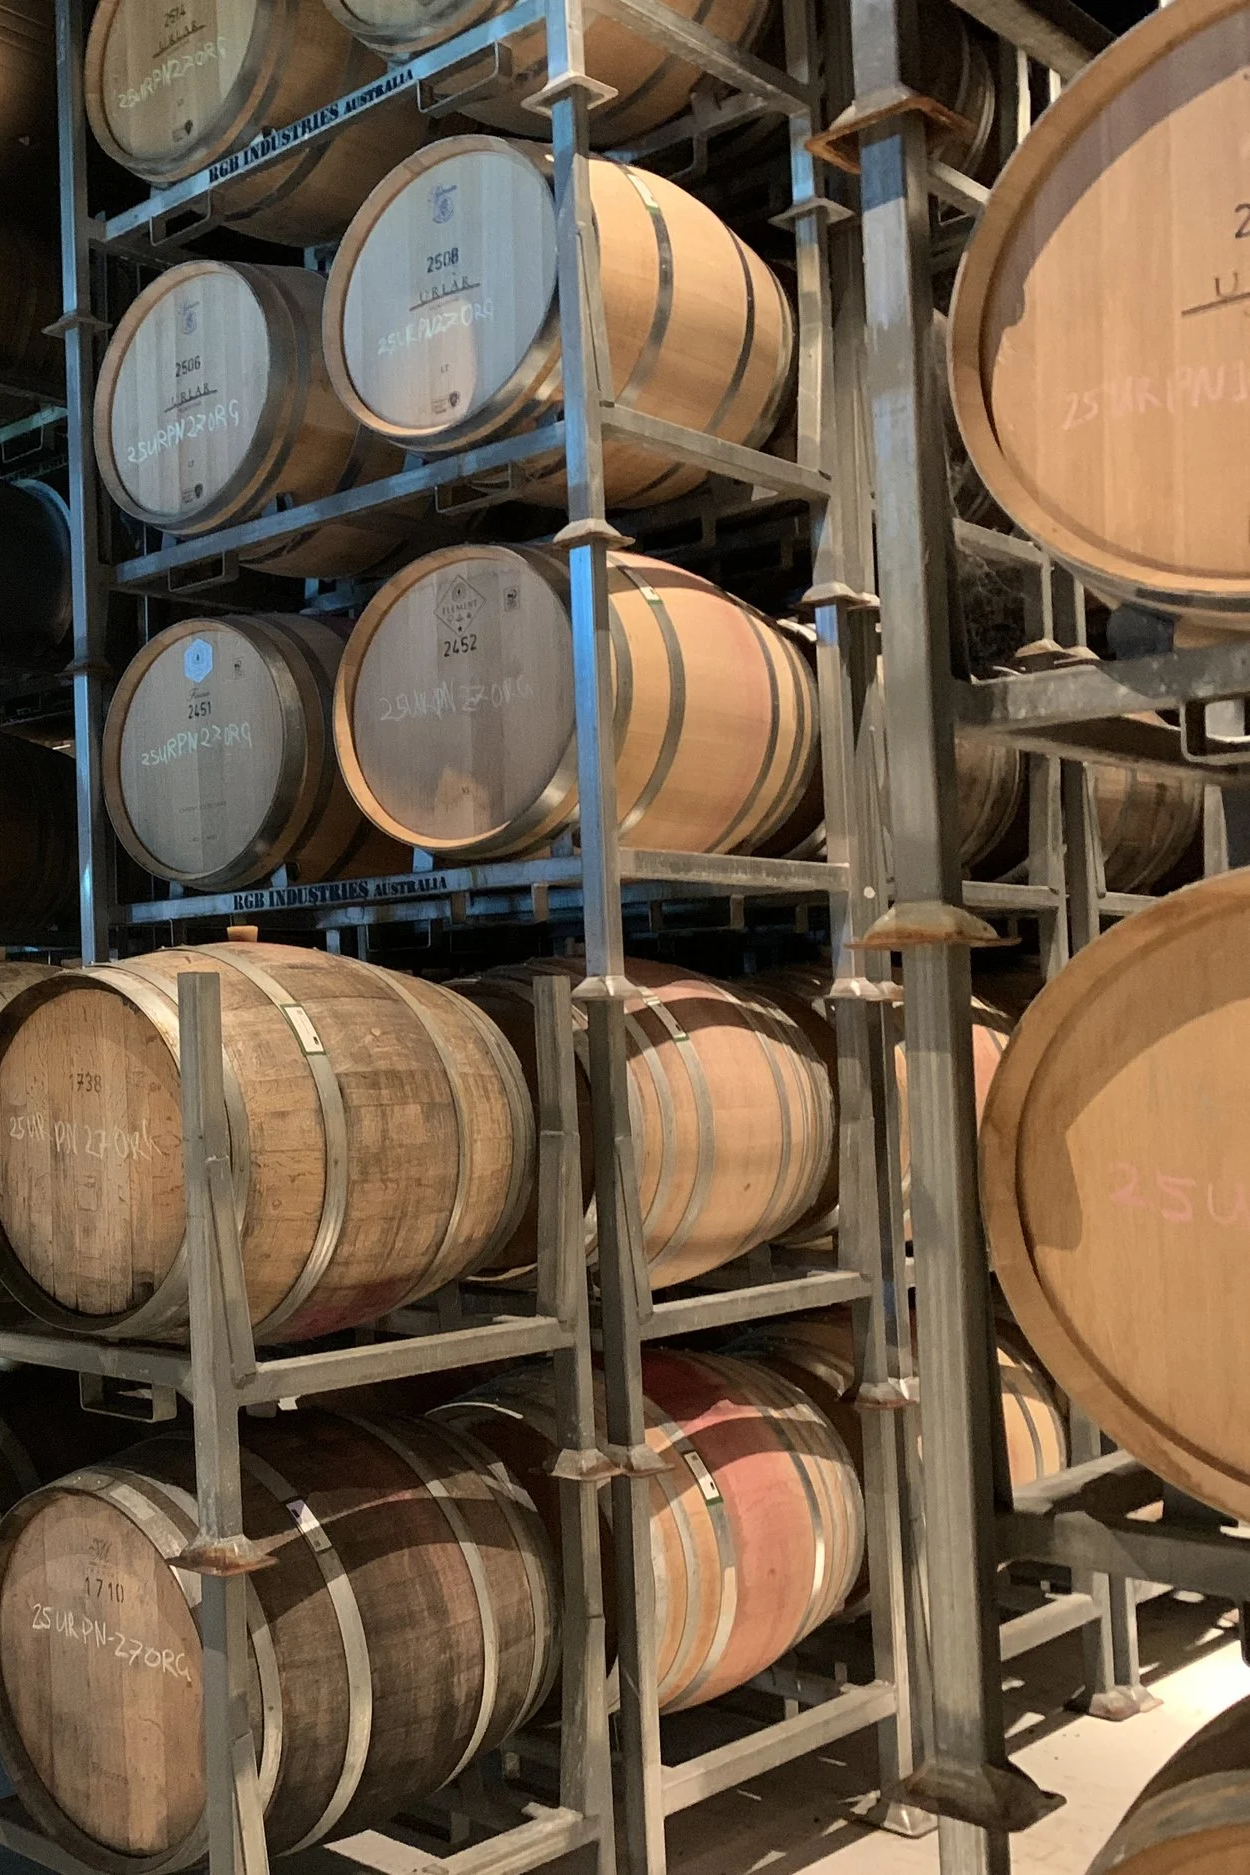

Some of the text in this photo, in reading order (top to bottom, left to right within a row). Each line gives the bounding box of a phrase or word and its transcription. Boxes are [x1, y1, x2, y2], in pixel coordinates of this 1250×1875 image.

[208, 68, 414, 183] RGB INDUSTRIES AUSTRALIA
[427, 247, 459, 273] 2508
[175, 356, 201, 378] 2506
[444, 633, 477, 657] 2452
[188, 701, 211, 719] 2451
[233, 876, 447, 911] RGB INDUSTRIES AUSTRALIA
[85, 1576, 124, 1604] 1710
